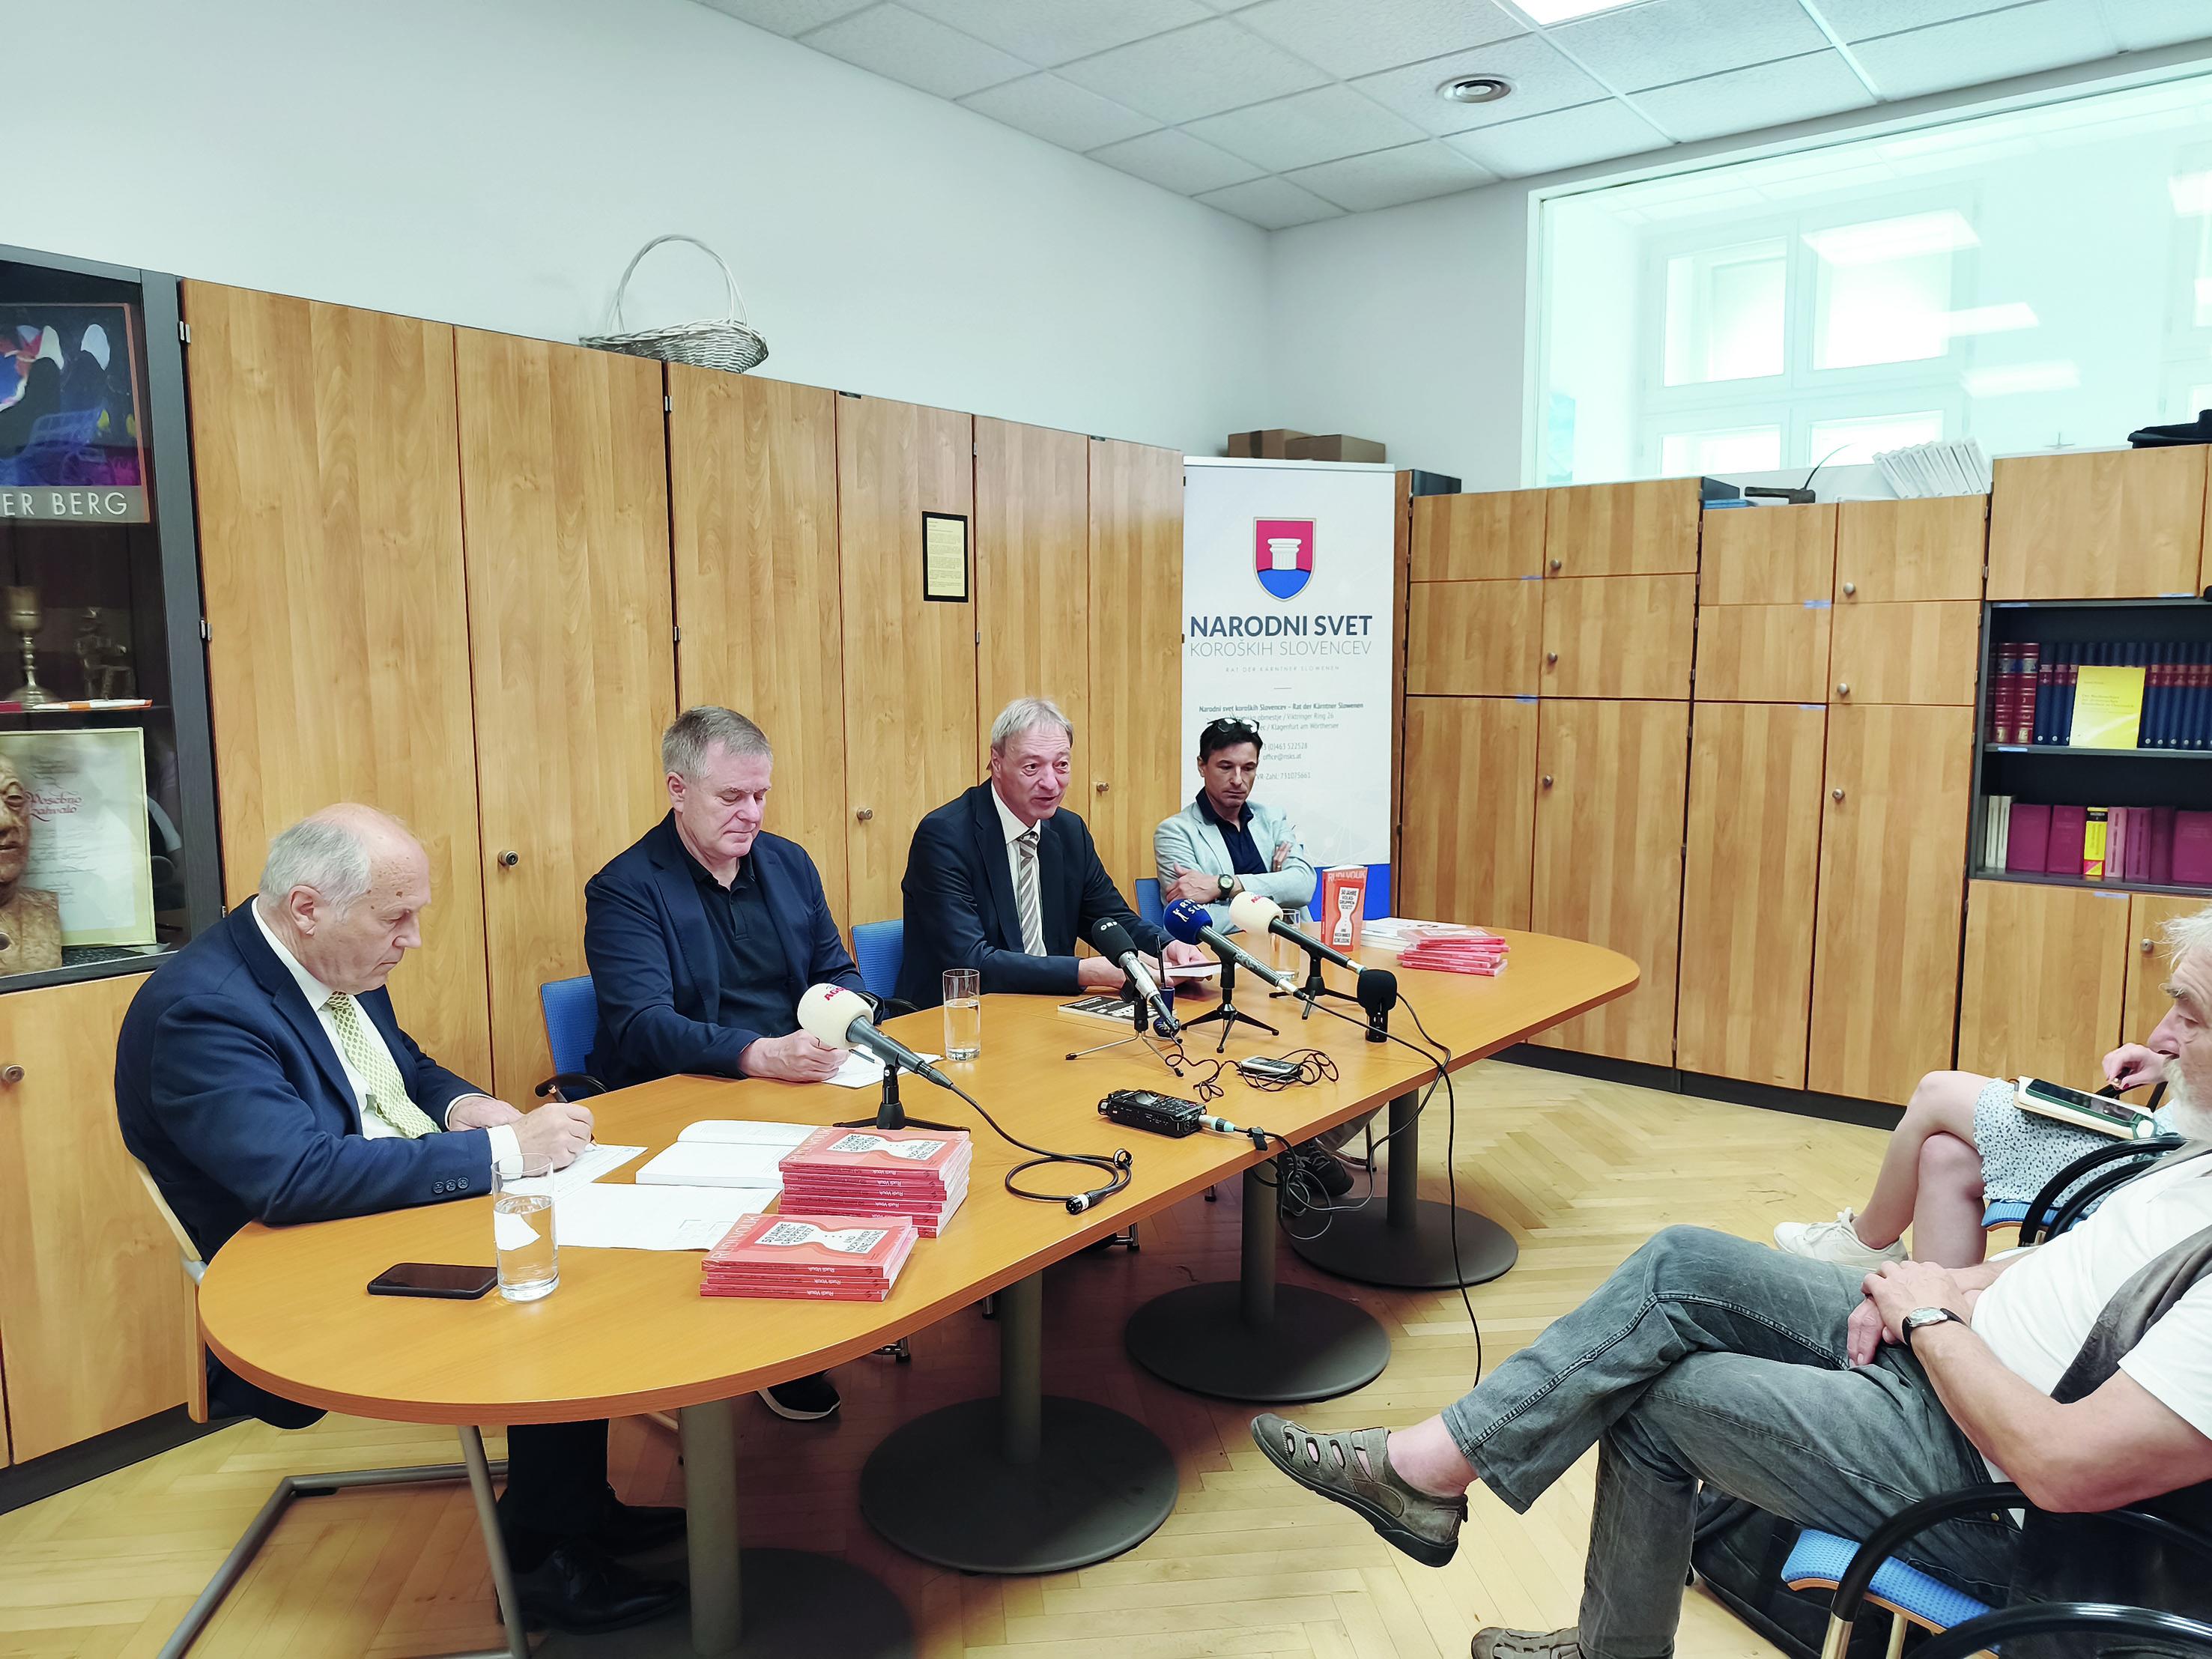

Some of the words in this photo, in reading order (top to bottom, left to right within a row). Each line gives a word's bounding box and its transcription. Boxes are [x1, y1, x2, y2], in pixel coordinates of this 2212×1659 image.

[52, 492, 127, 515] BERG
[1190, 616, 1308, 637] NARODNI
[1314, 615, 1373, 636] SVET
[1190, 640, 1273, 657] KOROŠKIH
[1279, 640, 1372, 656] SLOVENCEV
[1313, 712, 1326, 721] Ring
[1270, 723, 1299, 731] Klagenfurt
[824, 987, 846, 1001] AGO
[710, 1240, 739, 1258] RUDI
[730, 1215, 763, 1239] VOUK
